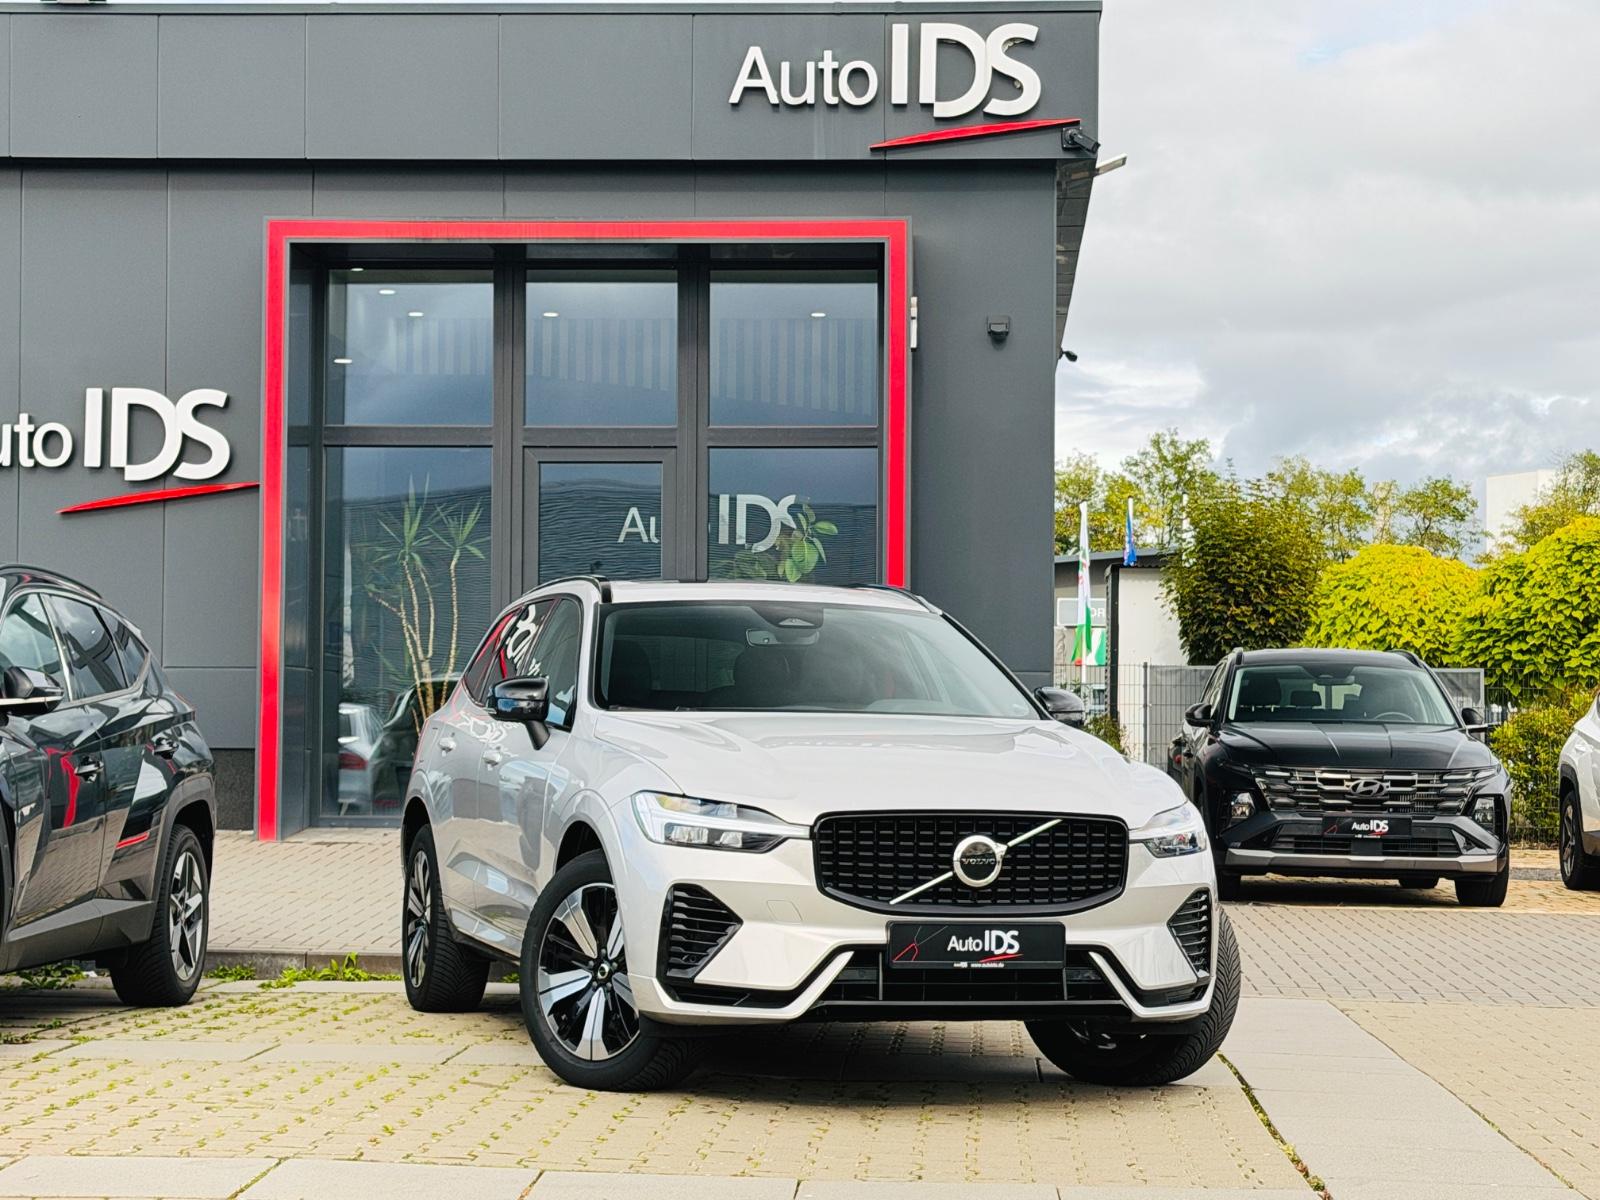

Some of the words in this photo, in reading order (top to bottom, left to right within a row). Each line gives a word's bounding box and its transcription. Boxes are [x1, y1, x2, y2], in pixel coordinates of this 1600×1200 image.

[729, 46, 878, 106] Auto
[891, 22, 1042, 118] IDS
[84, 387, 231, 481] IDS
[1351, 821, 1370, 831] Auto
[1370, 819, 1389, 833] IDS
[947, 935, 983, 952] Auto
[984, 929, 1020, 955] IDS
